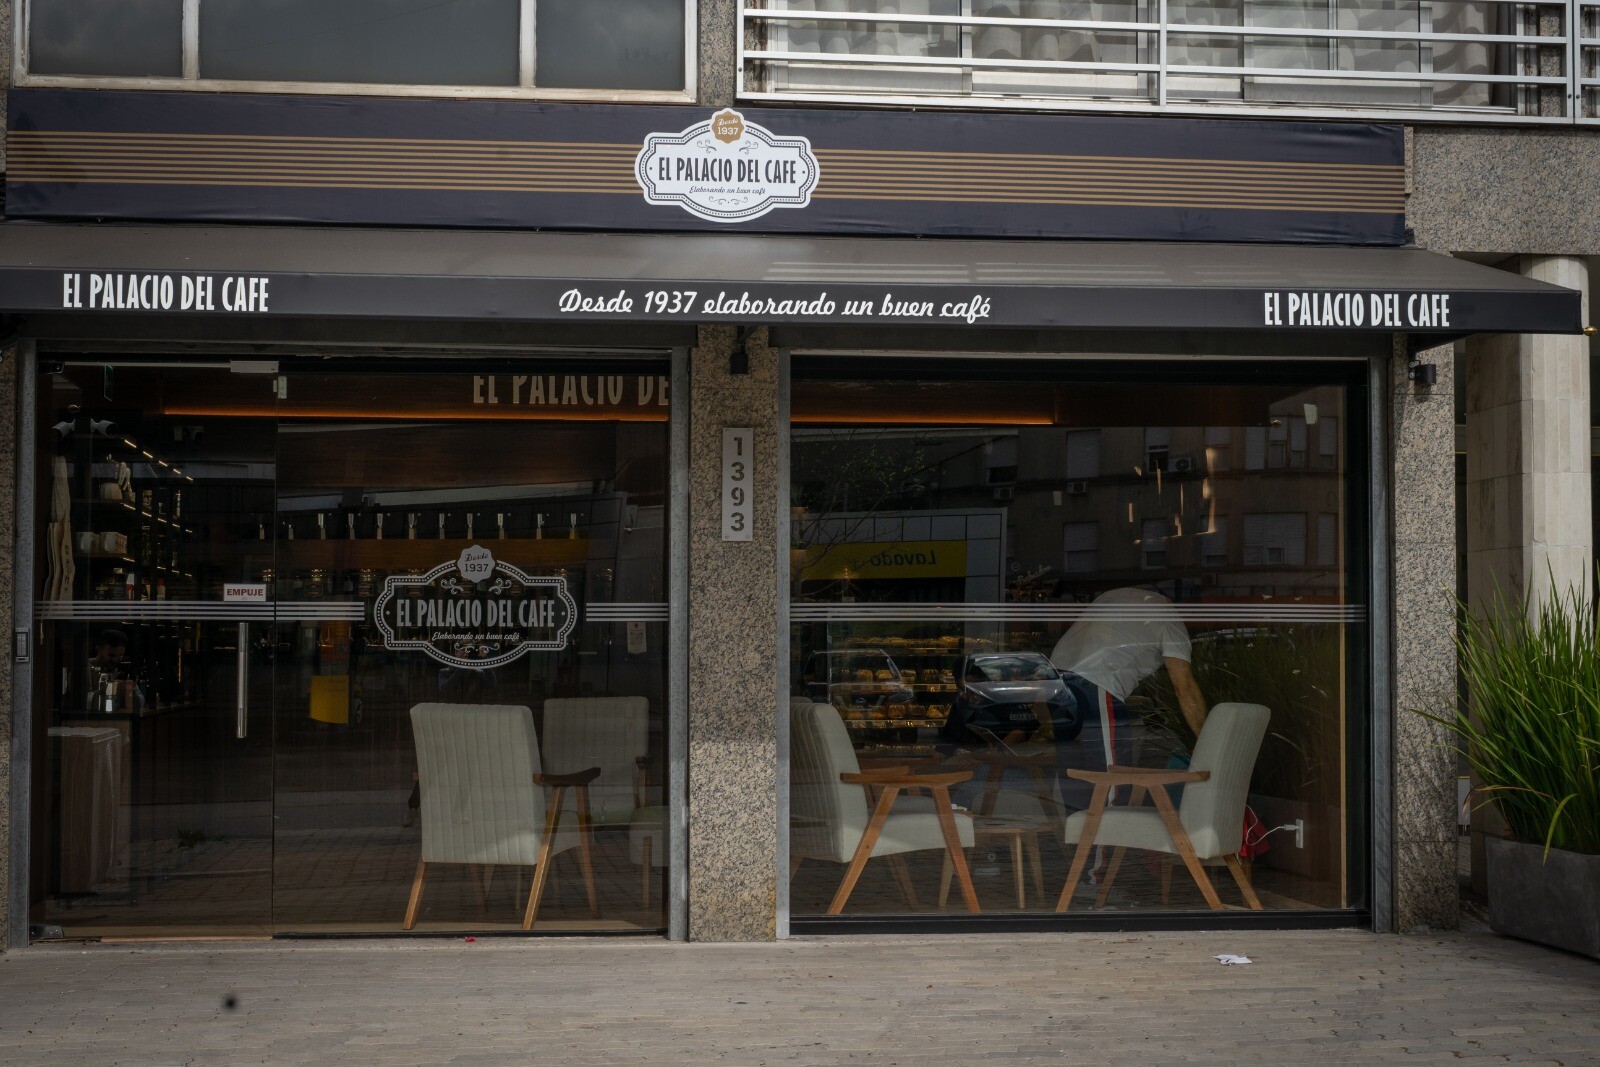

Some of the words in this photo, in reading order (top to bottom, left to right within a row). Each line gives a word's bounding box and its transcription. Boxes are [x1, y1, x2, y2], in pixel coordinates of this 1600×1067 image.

[717, 117, 739, 127] Desde
[717, 127, 739, 136] 1937
[658, 157, 672, 181] EL
[676, 157, 733, 183] PALACIO
[737, 159, 761, 183] DEL
[764, 159, 796, 184] CAFE
[689, 185, 725, 195] Elaborando
[63, 273, 82, 308] EL
[89, 273, 174, 310] PALACIO
[180, 275, 215, 311] DEL
[221, 276, 269, 312] CAFE
[558, 289, 633, 314] Desde
[643, 290, 698, 314] 1937
[701, 291, 836, 316] elaborando
[841, 299, 874, 316] un
[878, 294, 934, 317] buen
[939, 295, 991, 324] café
[1264, 292, 1282, 326] EL
[1288, 292, 1365, 327] PALACIO
[1370, 293, 1402, 327] DEL
[1407, 293, 1450, 327] CAFE
[473, 375, 499, 404] EL
[512, 375, 623, 405] PALACIO
[730, 436, 745, 532] 1393
[465, 552, 488, 562] Desde
[464, 563, 489, 572] 1937
[226, 588, 264, 596] EMPUJE
[396, 599, 412, 627] EL
[417, 599, 482, 627] PALACIO
[487, 599, 514, 628] DEL
[518, 599, 555, 628] CAFE
[432, 631, 474, 641] Elaborando
[486, 632, 503, 641] buen
